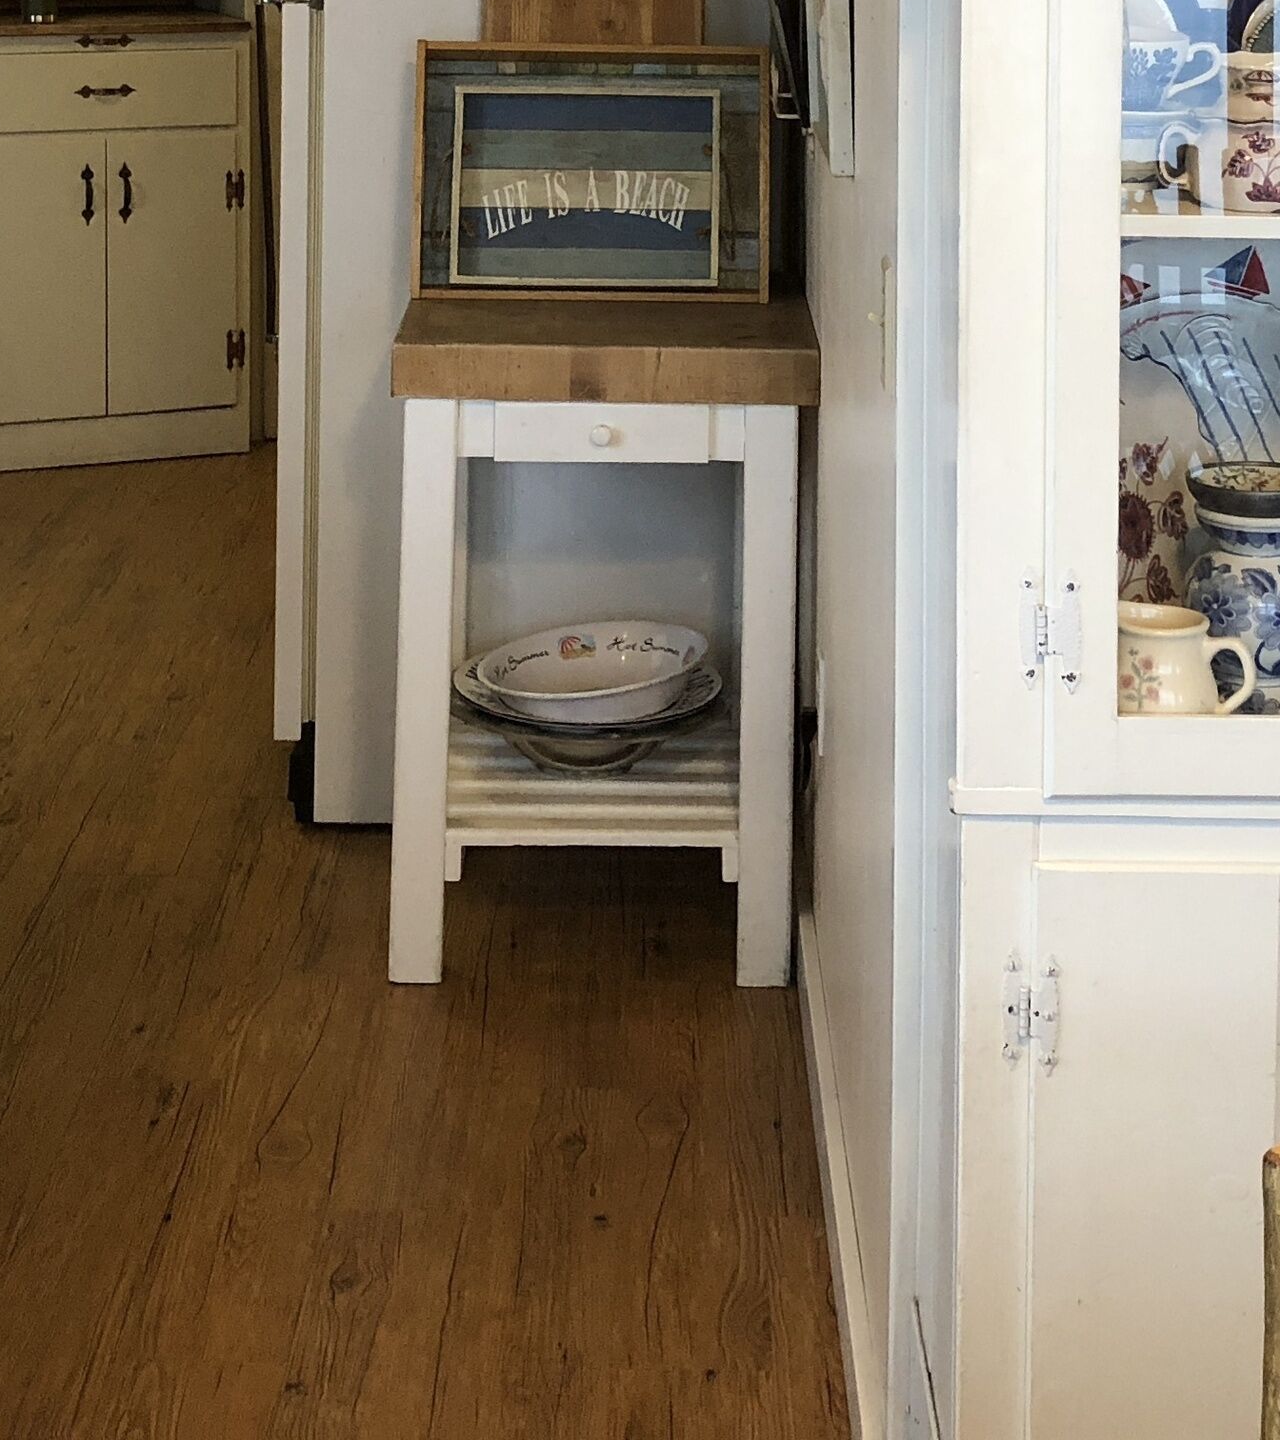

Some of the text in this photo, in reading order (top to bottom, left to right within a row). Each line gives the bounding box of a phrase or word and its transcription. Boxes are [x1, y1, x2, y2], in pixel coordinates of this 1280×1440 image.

[481, 167, 691, 240] LIFE IS A BEACH
